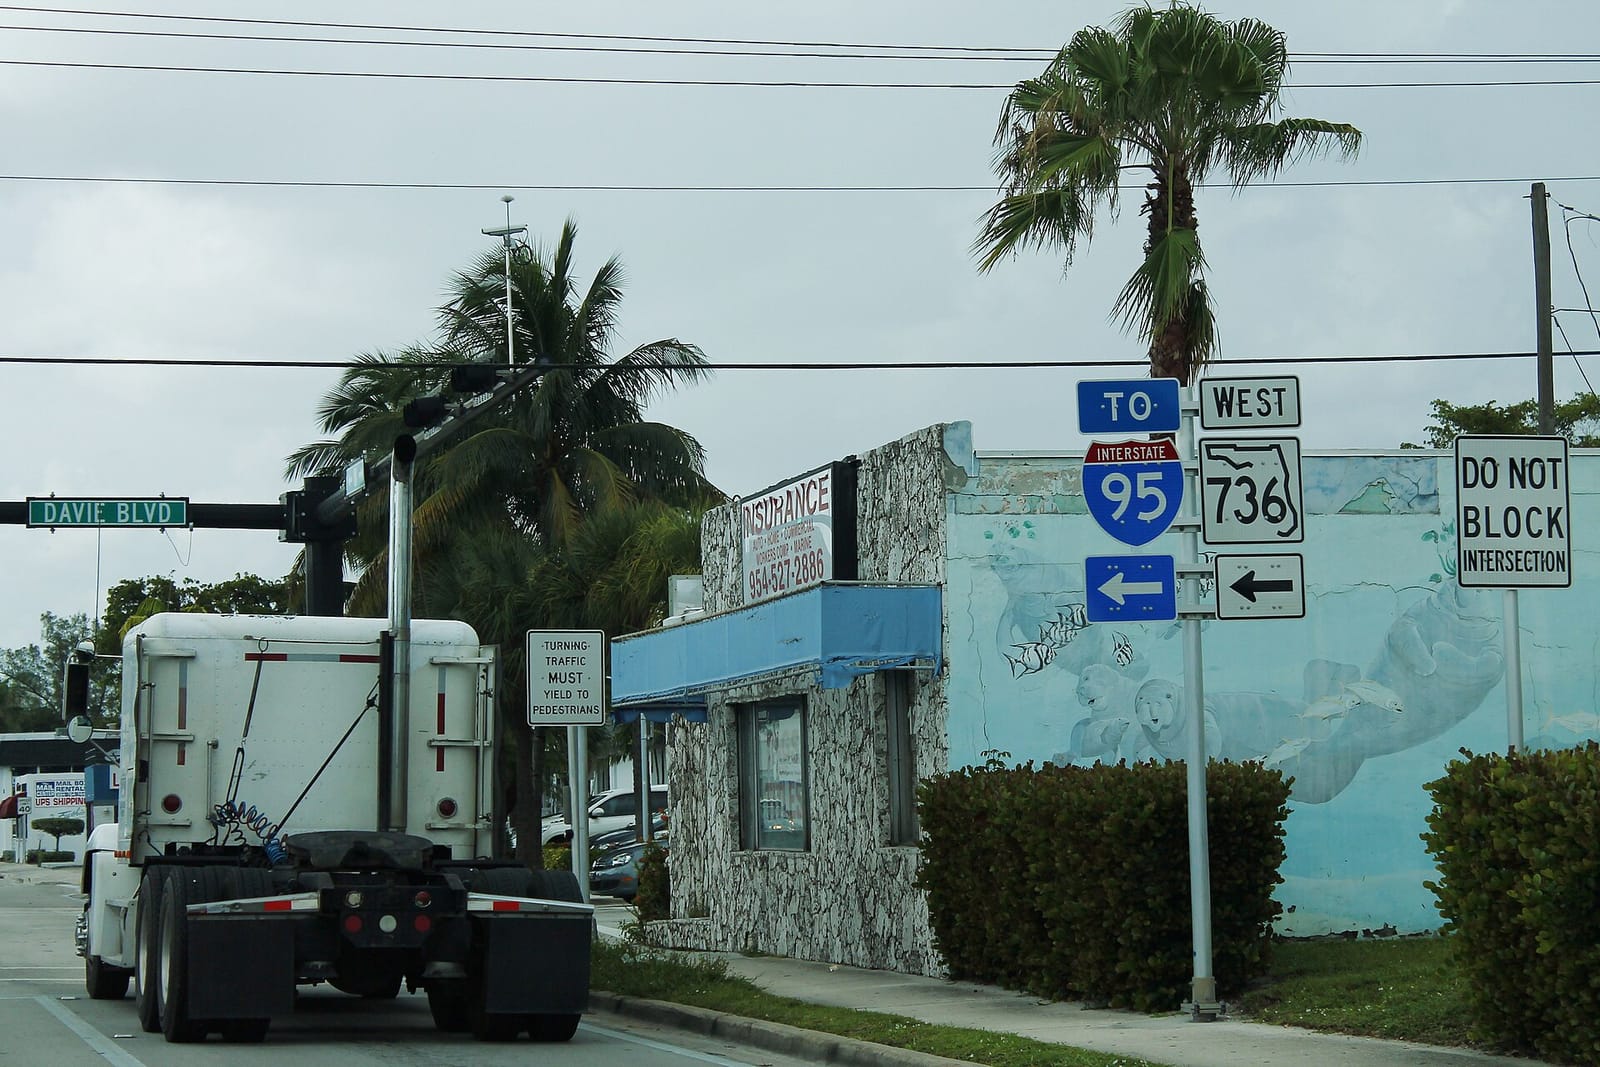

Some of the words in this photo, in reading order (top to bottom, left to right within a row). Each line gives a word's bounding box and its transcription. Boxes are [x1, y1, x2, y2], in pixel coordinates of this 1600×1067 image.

[1103, 391, 1151, 422] TO
[1213, 386, 1286, 418] WEST
[1097, 445, 1166, 462] INTERSTATE
[1462, 457, 1498, 489] DO
[1509, 457, 1562, 490] NOT
[743, 474, 829, 539] INSURANCE
[1101, 472, 1167, 522] 95
[1206, 475, 1287, 524] 736
[44, 502, 105, 523] DAVIE
[117, 502, 171, 523] BLVD
[1463, 506, 1564, 539] BLOCK
[767, 530, 779, 545] HOME
[784, 518, 815, 540] COMMERCIAL
[794, 536, 812, 553] MARINE
[1463, 550, 1566, 573] INTERSECTION
[544, 641, 587, 651] TURNING
[545, 656, 586, 666] TRAFFIC
[548, 672, 583, 684] MUST
[544, 690, 572, 699] YIELD
[577, 690, 589, 699] TO
[533, 705, 600, 715] PEDESTRIANS
[36, 798, 50, 806] UPS
[53, 797, 86, 806] SHIPPIN
